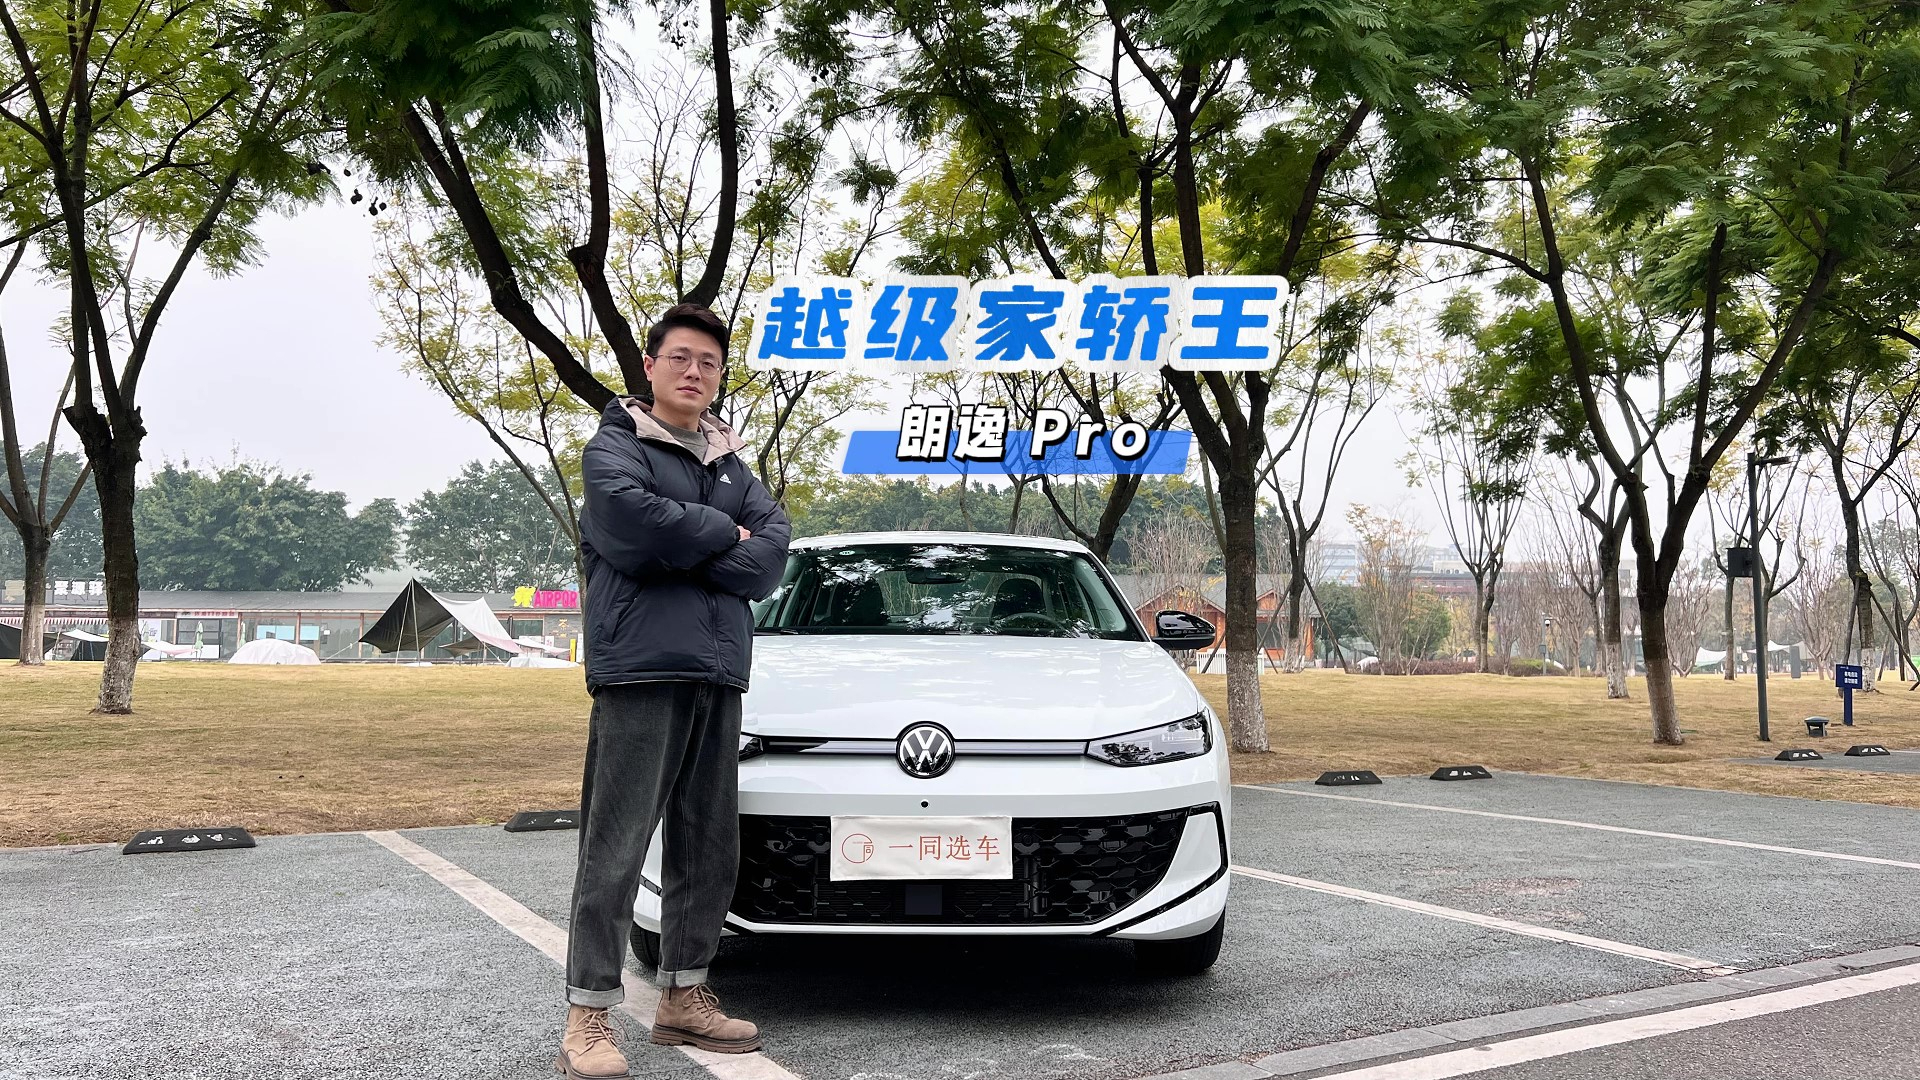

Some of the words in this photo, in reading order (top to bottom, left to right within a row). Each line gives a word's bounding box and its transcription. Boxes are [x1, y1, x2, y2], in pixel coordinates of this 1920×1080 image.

[533, 590, 579, 608] AIRPOR
[888, 834, 1000, 862] 一同选车
